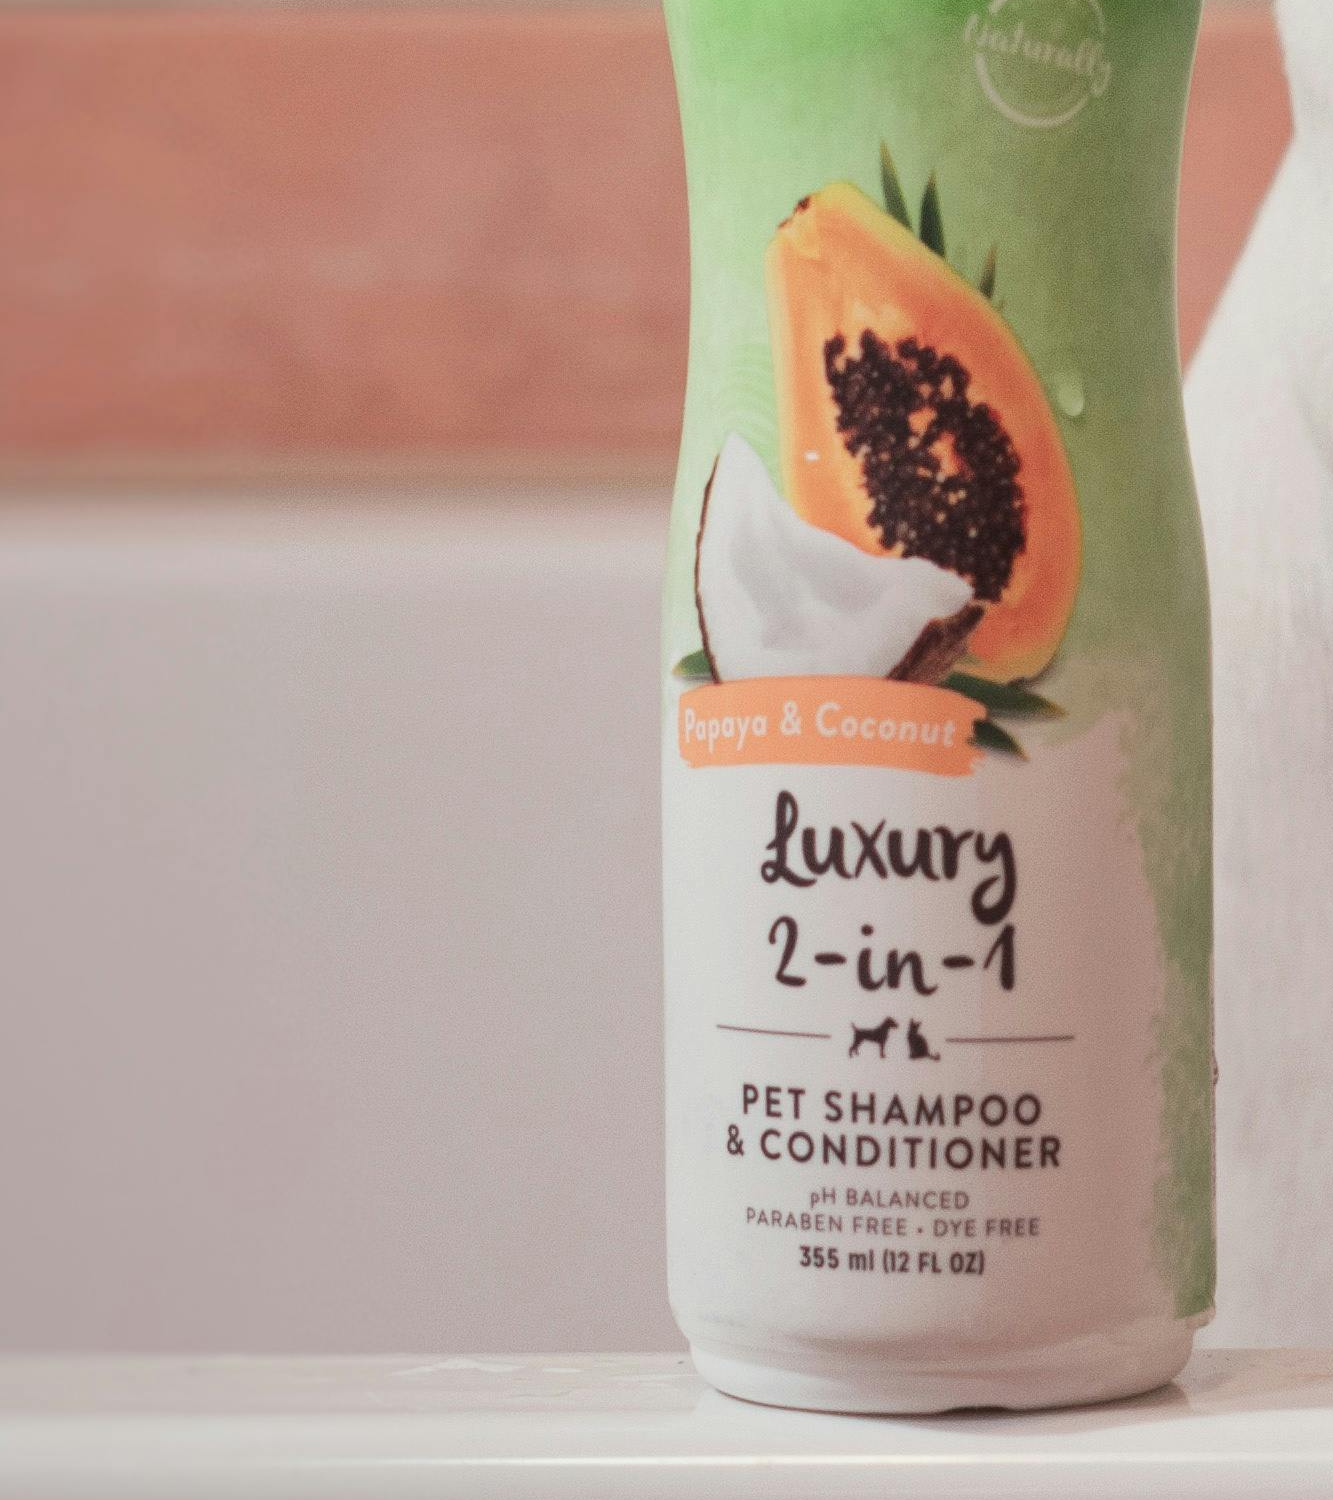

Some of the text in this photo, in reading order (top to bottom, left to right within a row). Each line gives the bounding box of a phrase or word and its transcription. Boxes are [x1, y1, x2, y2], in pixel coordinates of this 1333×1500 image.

[684, 702, 956, 753] Papaya & Coconut
[760, 790, 1017, 926] Luxury
[767, 915, 1016, 996] 2-in-1
[742, 1083, 1042, 1127] PET SHAMPOO
[726, 1124, 1061, 1170] & CONDITIONER
[809, 1186, 970, 1211] pH BALANCED
[745, 1207, 1040, 1238] PARABEN FREE DYE FREE
[799, 1246, 985, 1276] 355 ml (12 FL OZ)
